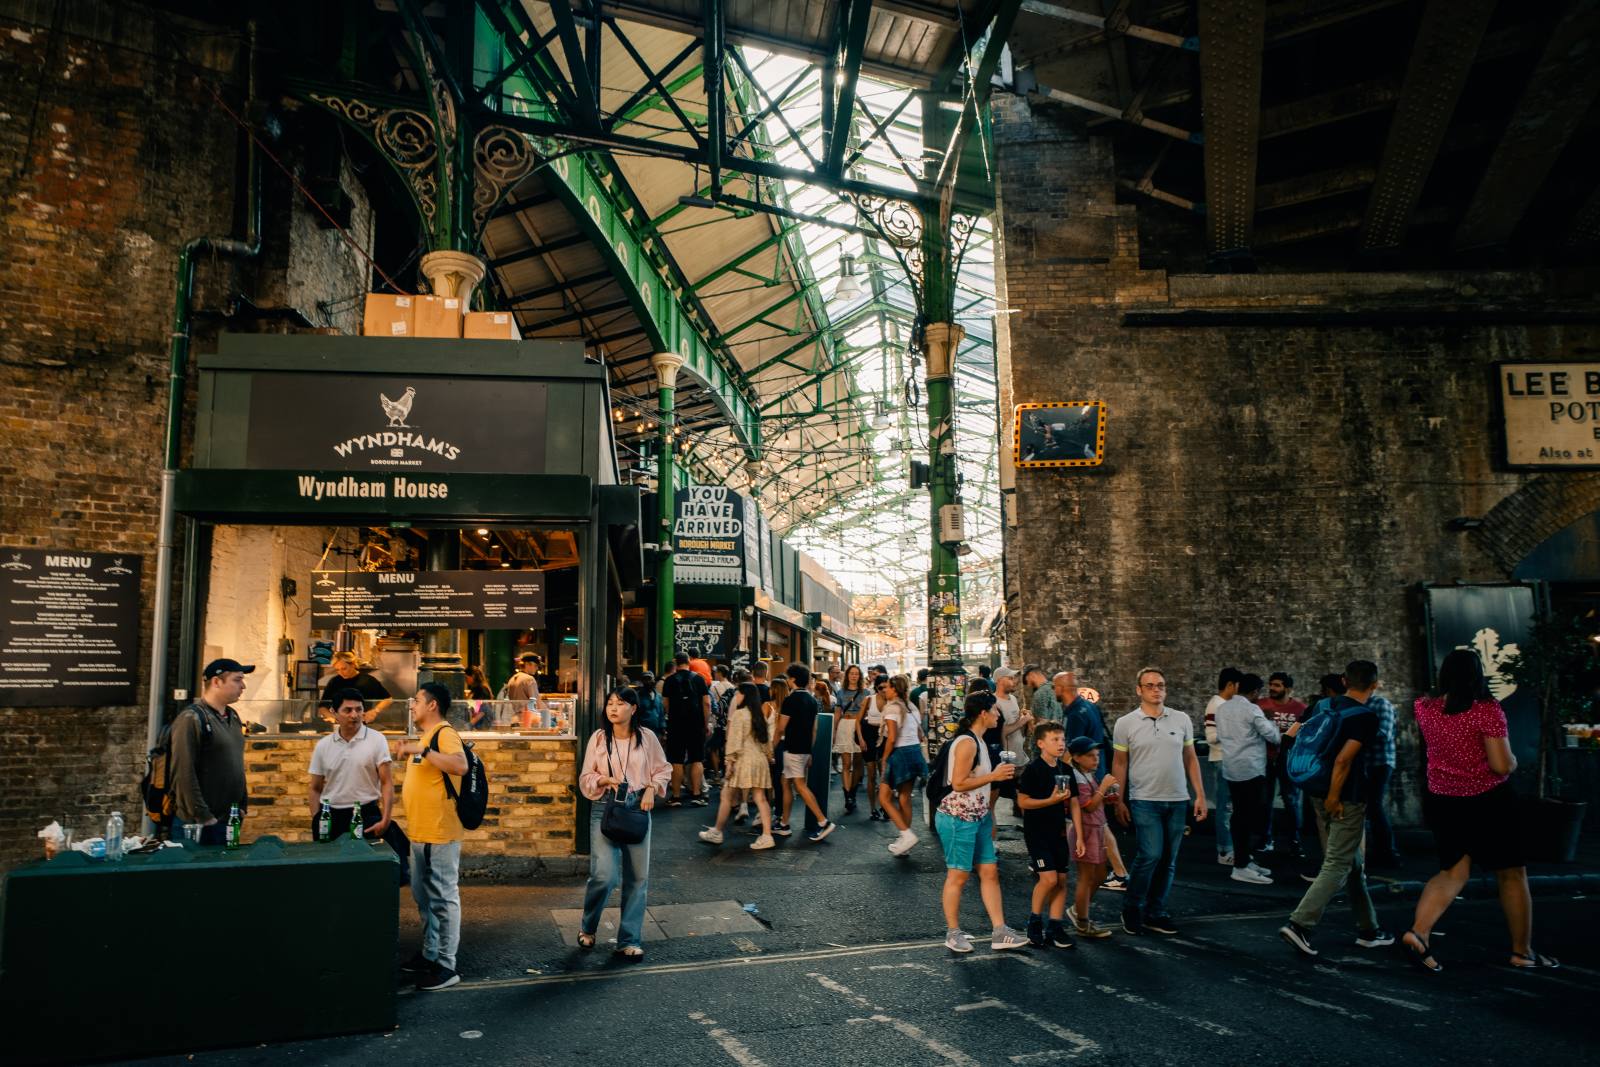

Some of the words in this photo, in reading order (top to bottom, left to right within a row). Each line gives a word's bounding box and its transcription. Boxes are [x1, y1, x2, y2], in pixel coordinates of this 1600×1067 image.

[1506, 372, 1569, 396] LEE
[333, 431, 461, 460] WYNDHAM'S
[1539, 447, 1571, 458] Also
[1577, 448, 1593, 458] at
[298, 475, 386, 500] Wyndham
[393, 477, 448, 499] House
[691, 487, 726, 501] YOU
[684, 504, 731, 518] HAVE
[676, 521, 740, 535] ARRIVED
[678, 539, 710, 550] BOROUGH
[710, 540, 736, 551] MARKET
[45, 555, 92, 568] MENU
[717, 556, 736, 565] FARM
[378, 573, 415, 583] MENU
[676, 624, 696, 633] SALT
[698, 624, 724, 635] BEEF
